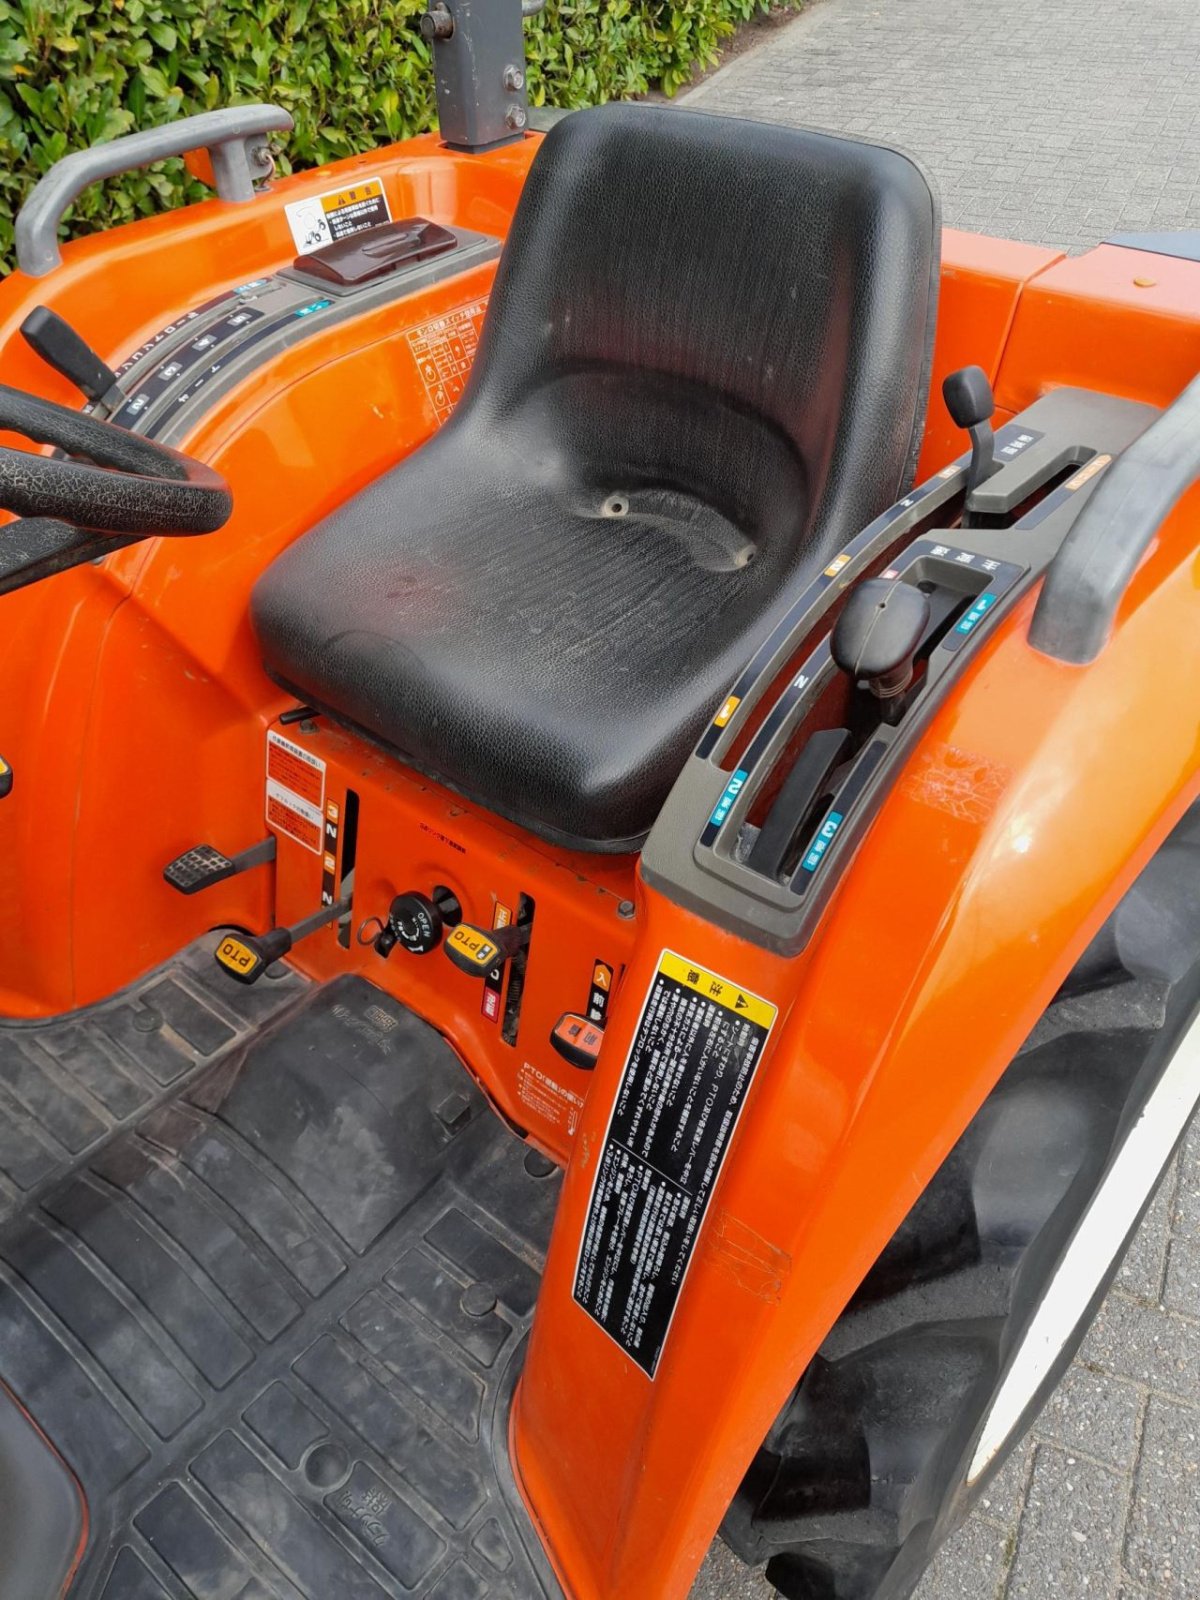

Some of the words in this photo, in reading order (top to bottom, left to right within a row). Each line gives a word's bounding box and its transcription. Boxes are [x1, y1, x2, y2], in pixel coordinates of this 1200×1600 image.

[930, 545, 1001, 571] 主変速
[793, 675, 809, 689] N
[327, 804, 338, 817] 3
[326, 823, 337, 838] N
[322, 891, 332, 905] N
[417, 912, 431, 938] OPEN
[454, 931, 480, 950] PTO
[222, 942, 251, 967] PTO
[596, 972, 606, 985] 入
[686, 968, 723, 998] 注意
[711, 1019, 730, 1059] にすること
